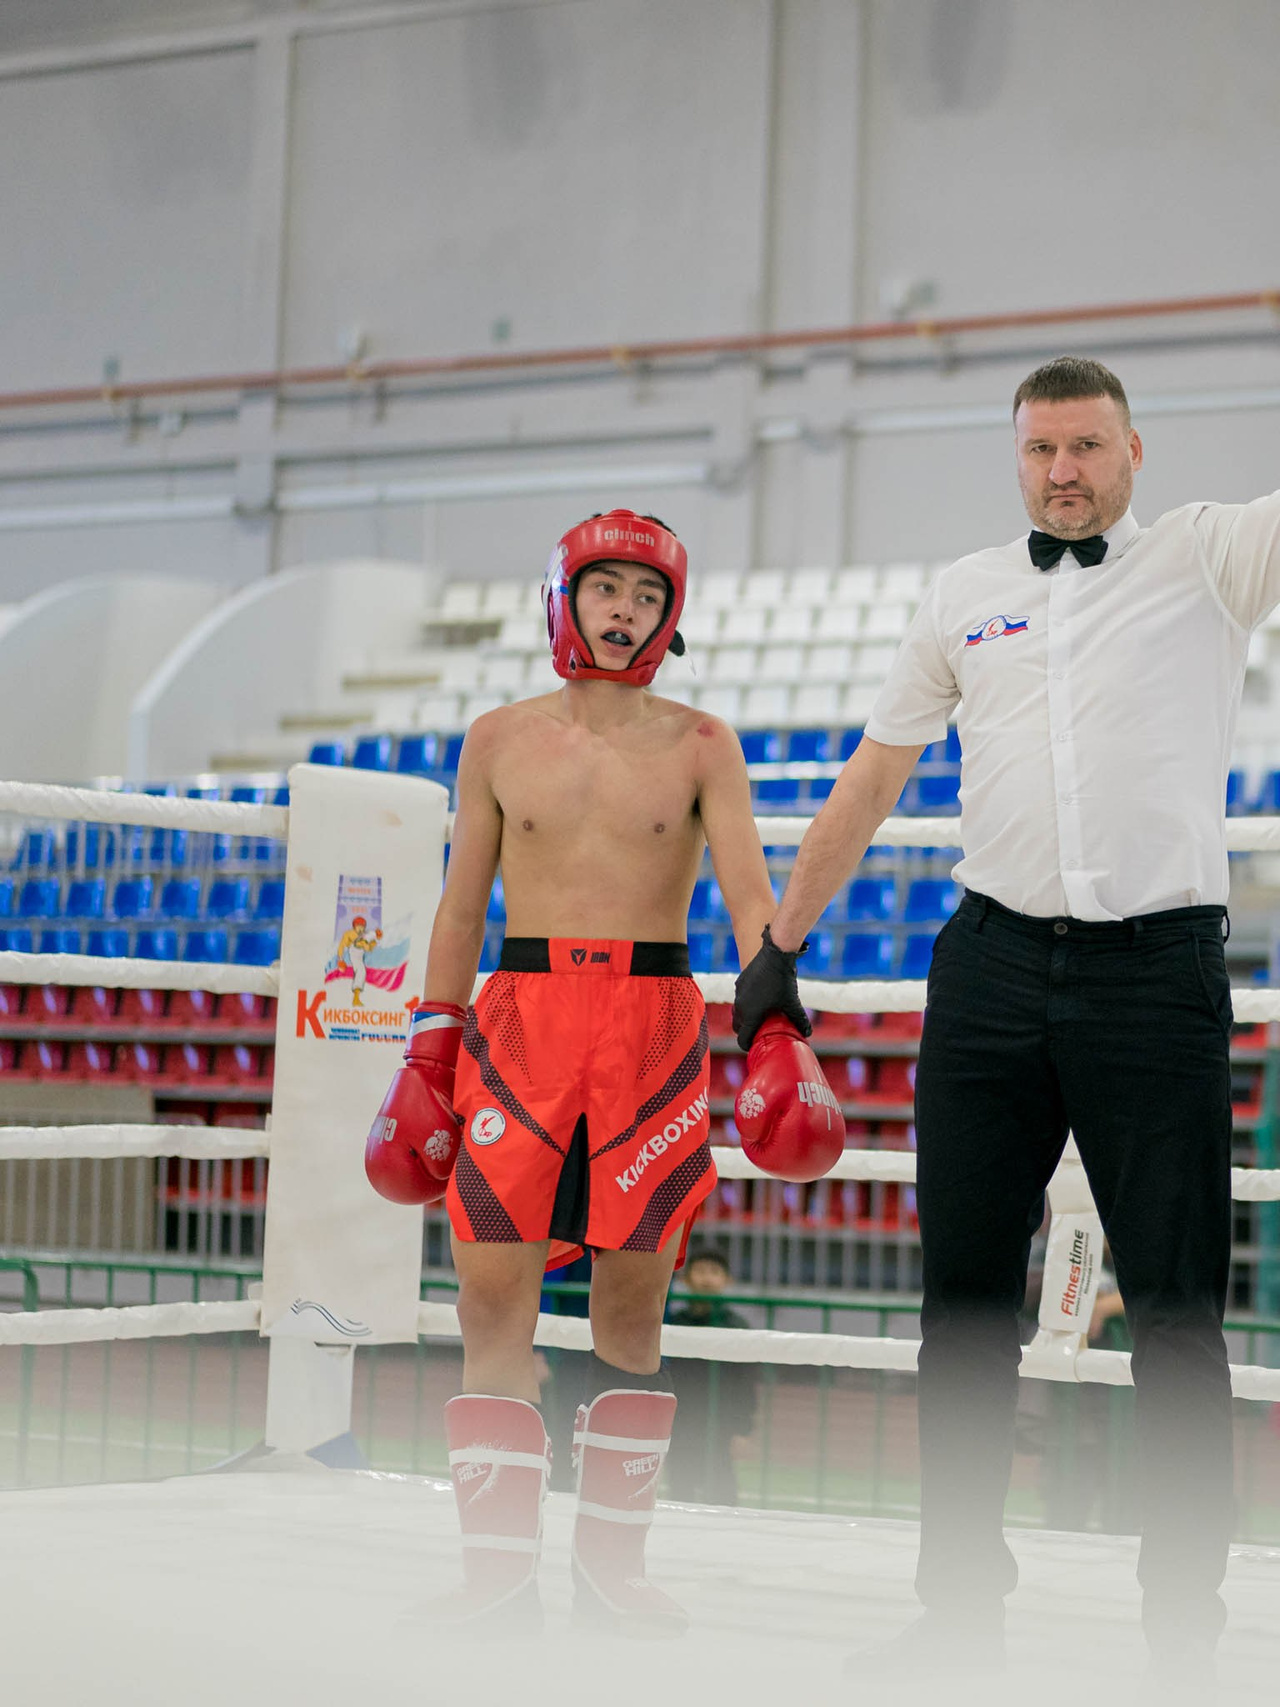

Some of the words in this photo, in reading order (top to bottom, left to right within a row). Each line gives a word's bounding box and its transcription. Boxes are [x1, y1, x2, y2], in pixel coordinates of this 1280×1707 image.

[604, 528, 655, 547] clinch
[615, 1086, 710, 1193] KICKBOXIN
[1061, 1229, 1084, 1316] Fitnestime
